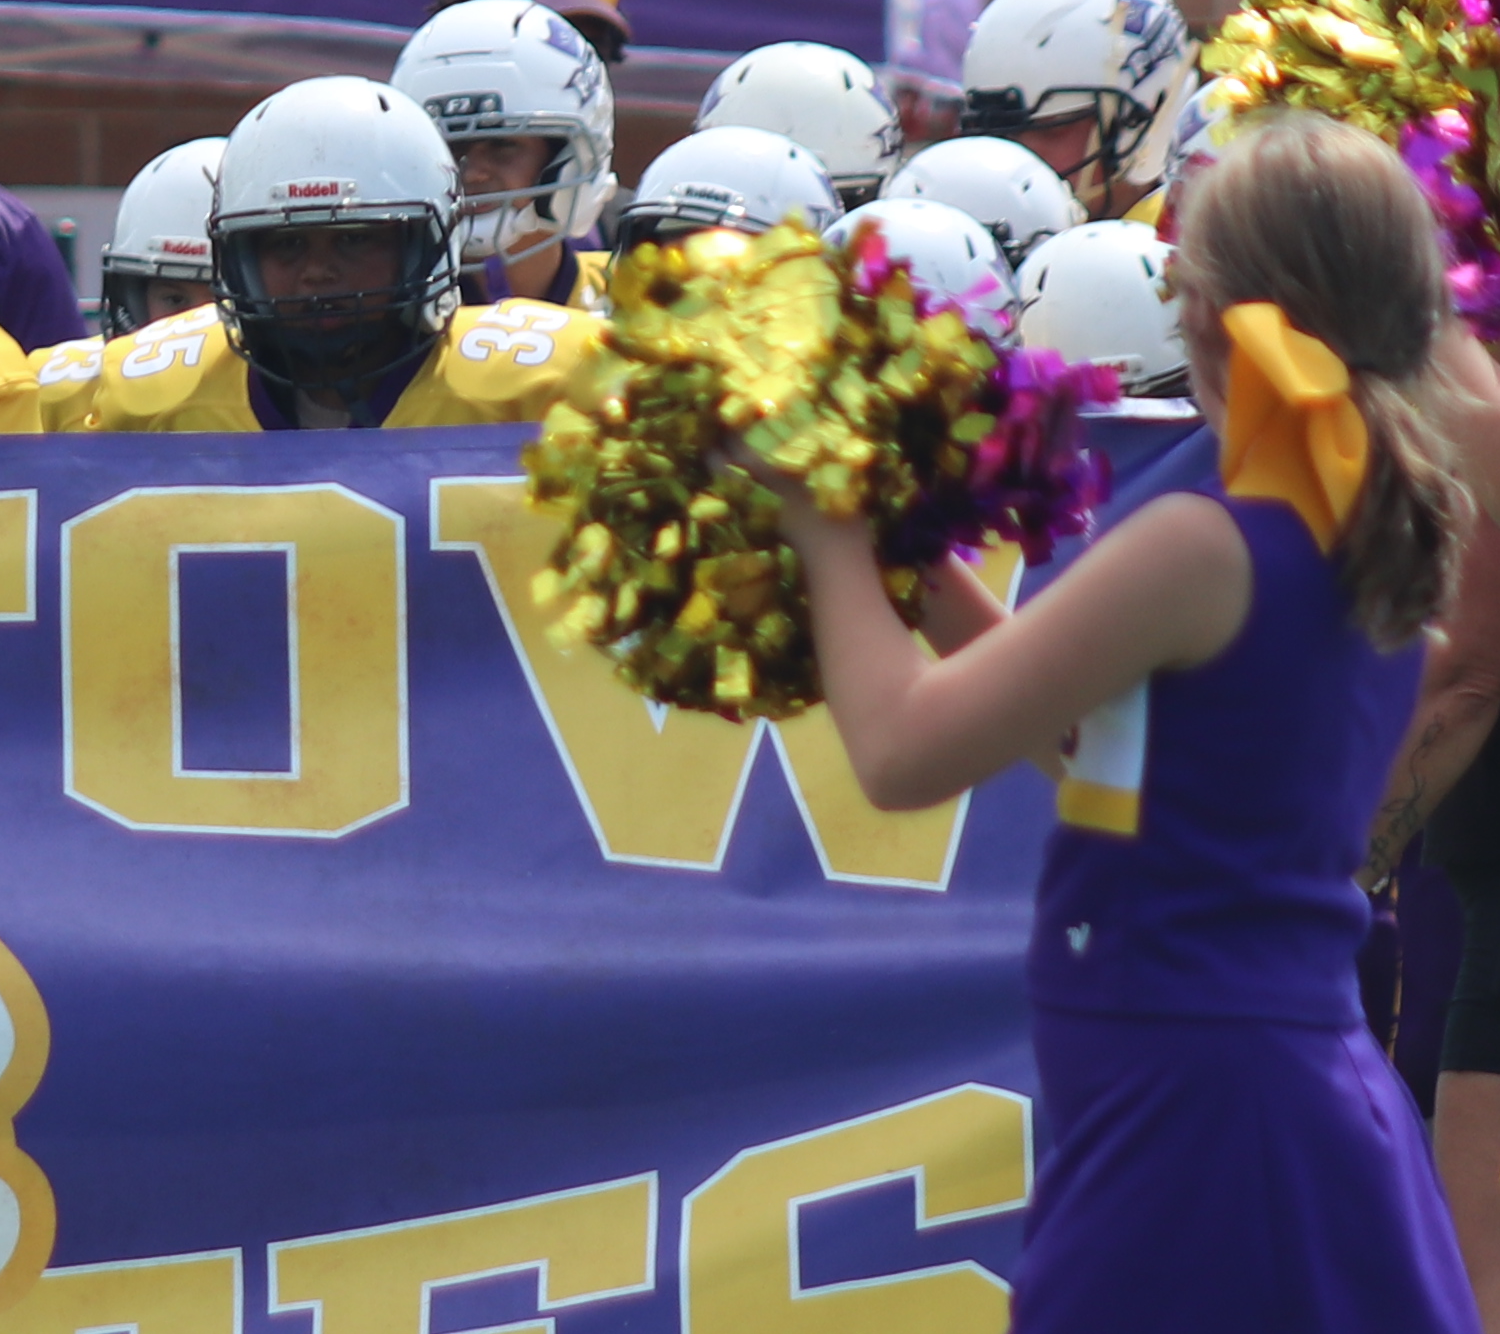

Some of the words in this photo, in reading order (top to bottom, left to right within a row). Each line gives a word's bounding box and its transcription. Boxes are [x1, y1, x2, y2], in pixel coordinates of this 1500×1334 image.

[289, 183, 339, 198] Riddell
[163, 240, 207, 255] Riddell
[121, 303, 221, 379] 35
